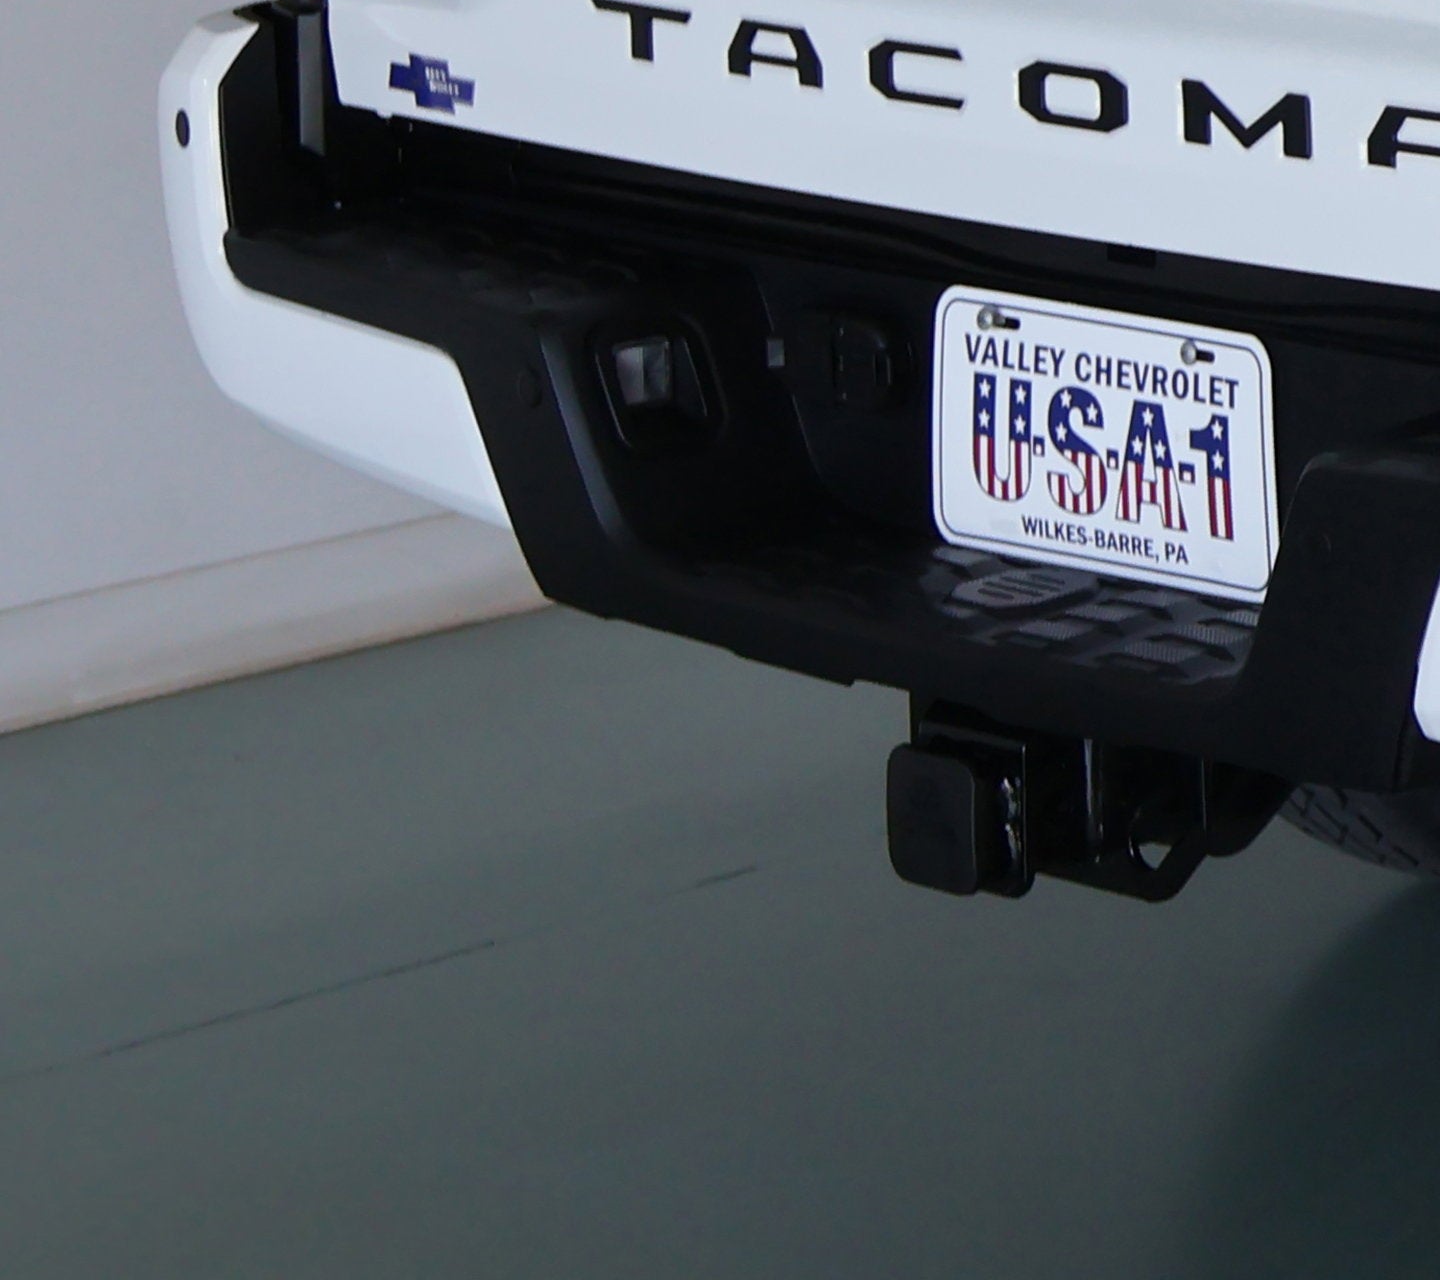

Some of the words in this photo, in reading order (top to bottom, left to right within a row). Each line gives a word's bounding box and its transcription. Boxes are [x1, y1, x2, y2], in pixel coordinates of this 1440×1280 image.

[964, 332, 1066, 378] VALLEY
[1074, 351, 1239, 409] CHEVROLET
[1021, 515, 1160, 563] WILKES-BARRE,
[1164, 542, 1190, 565] PA
